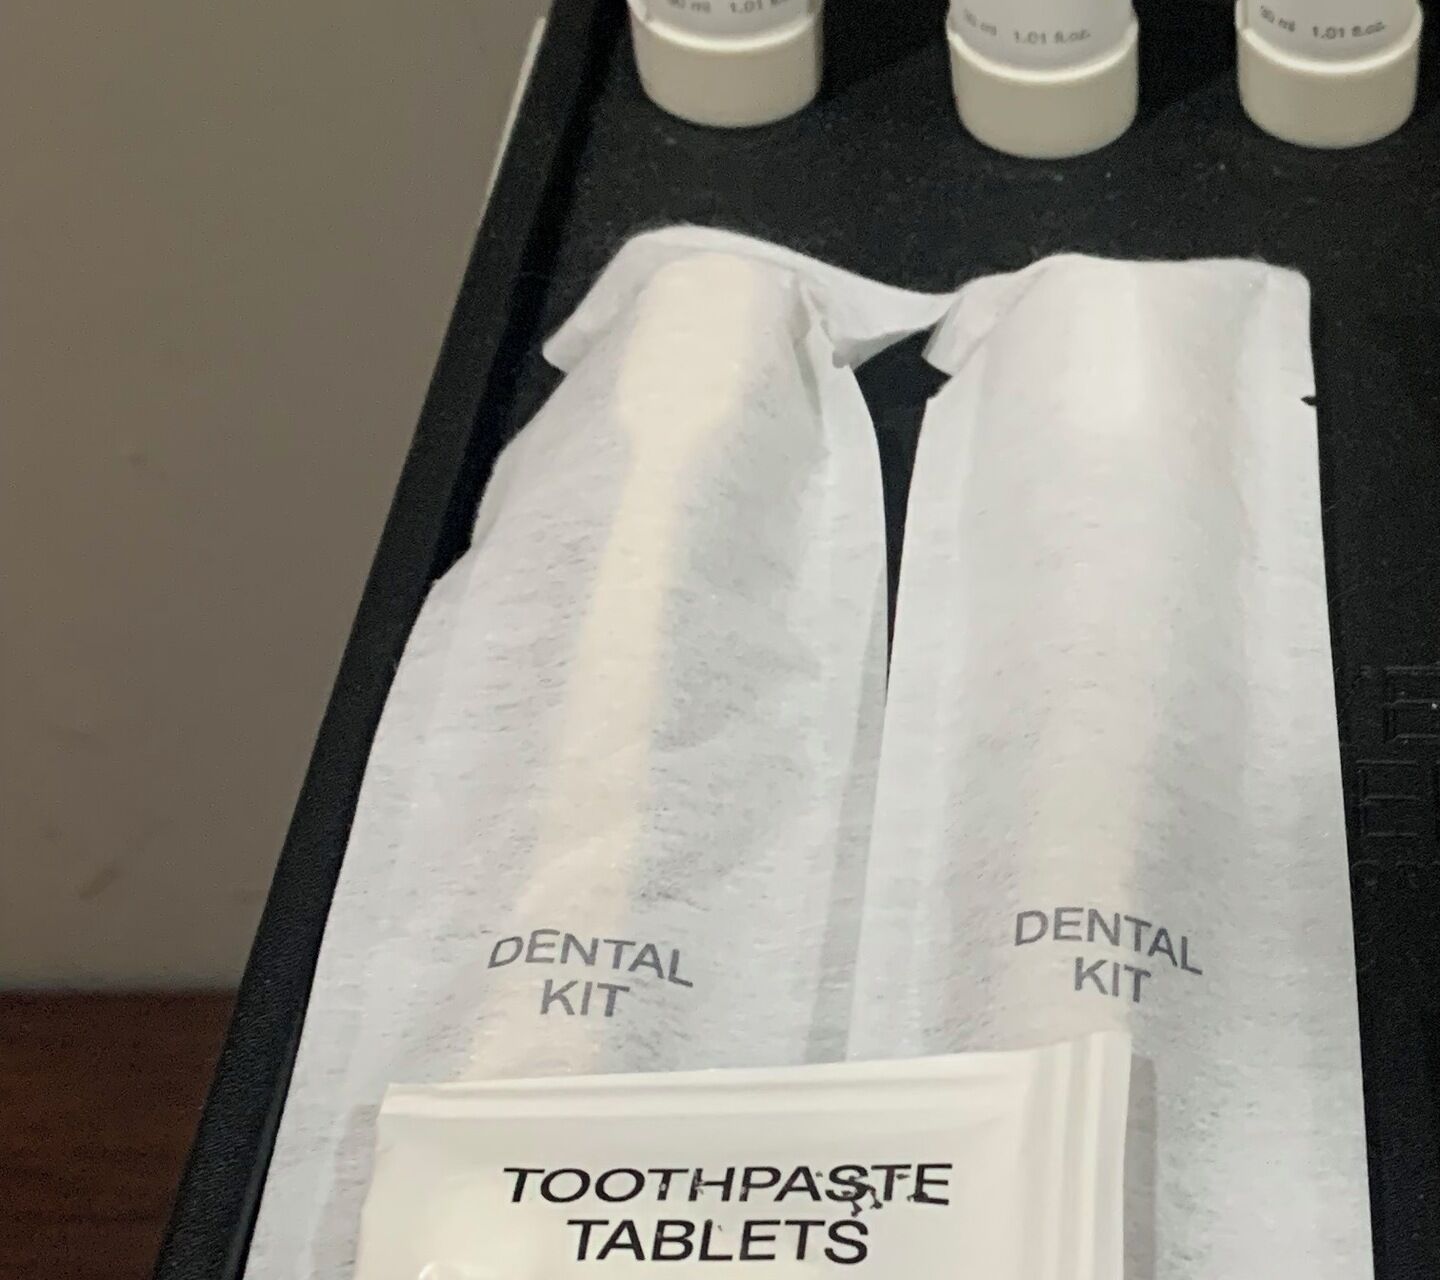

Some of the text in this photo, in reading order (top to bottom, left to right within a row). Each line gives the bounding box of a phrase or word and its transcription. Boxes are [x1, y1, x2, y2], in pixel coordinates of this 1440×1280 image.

[487, 928, 694, 988] DENTAL
[1015, 906, 1203, 976] DENTAL
[540, 979, 630, 1018] KIT
[1074, 956, 1152, 1004] KIT
[503, 1162, 953, 1207] TOOTHPASTE
[567, 1218, 870, 1266] TABLETS
